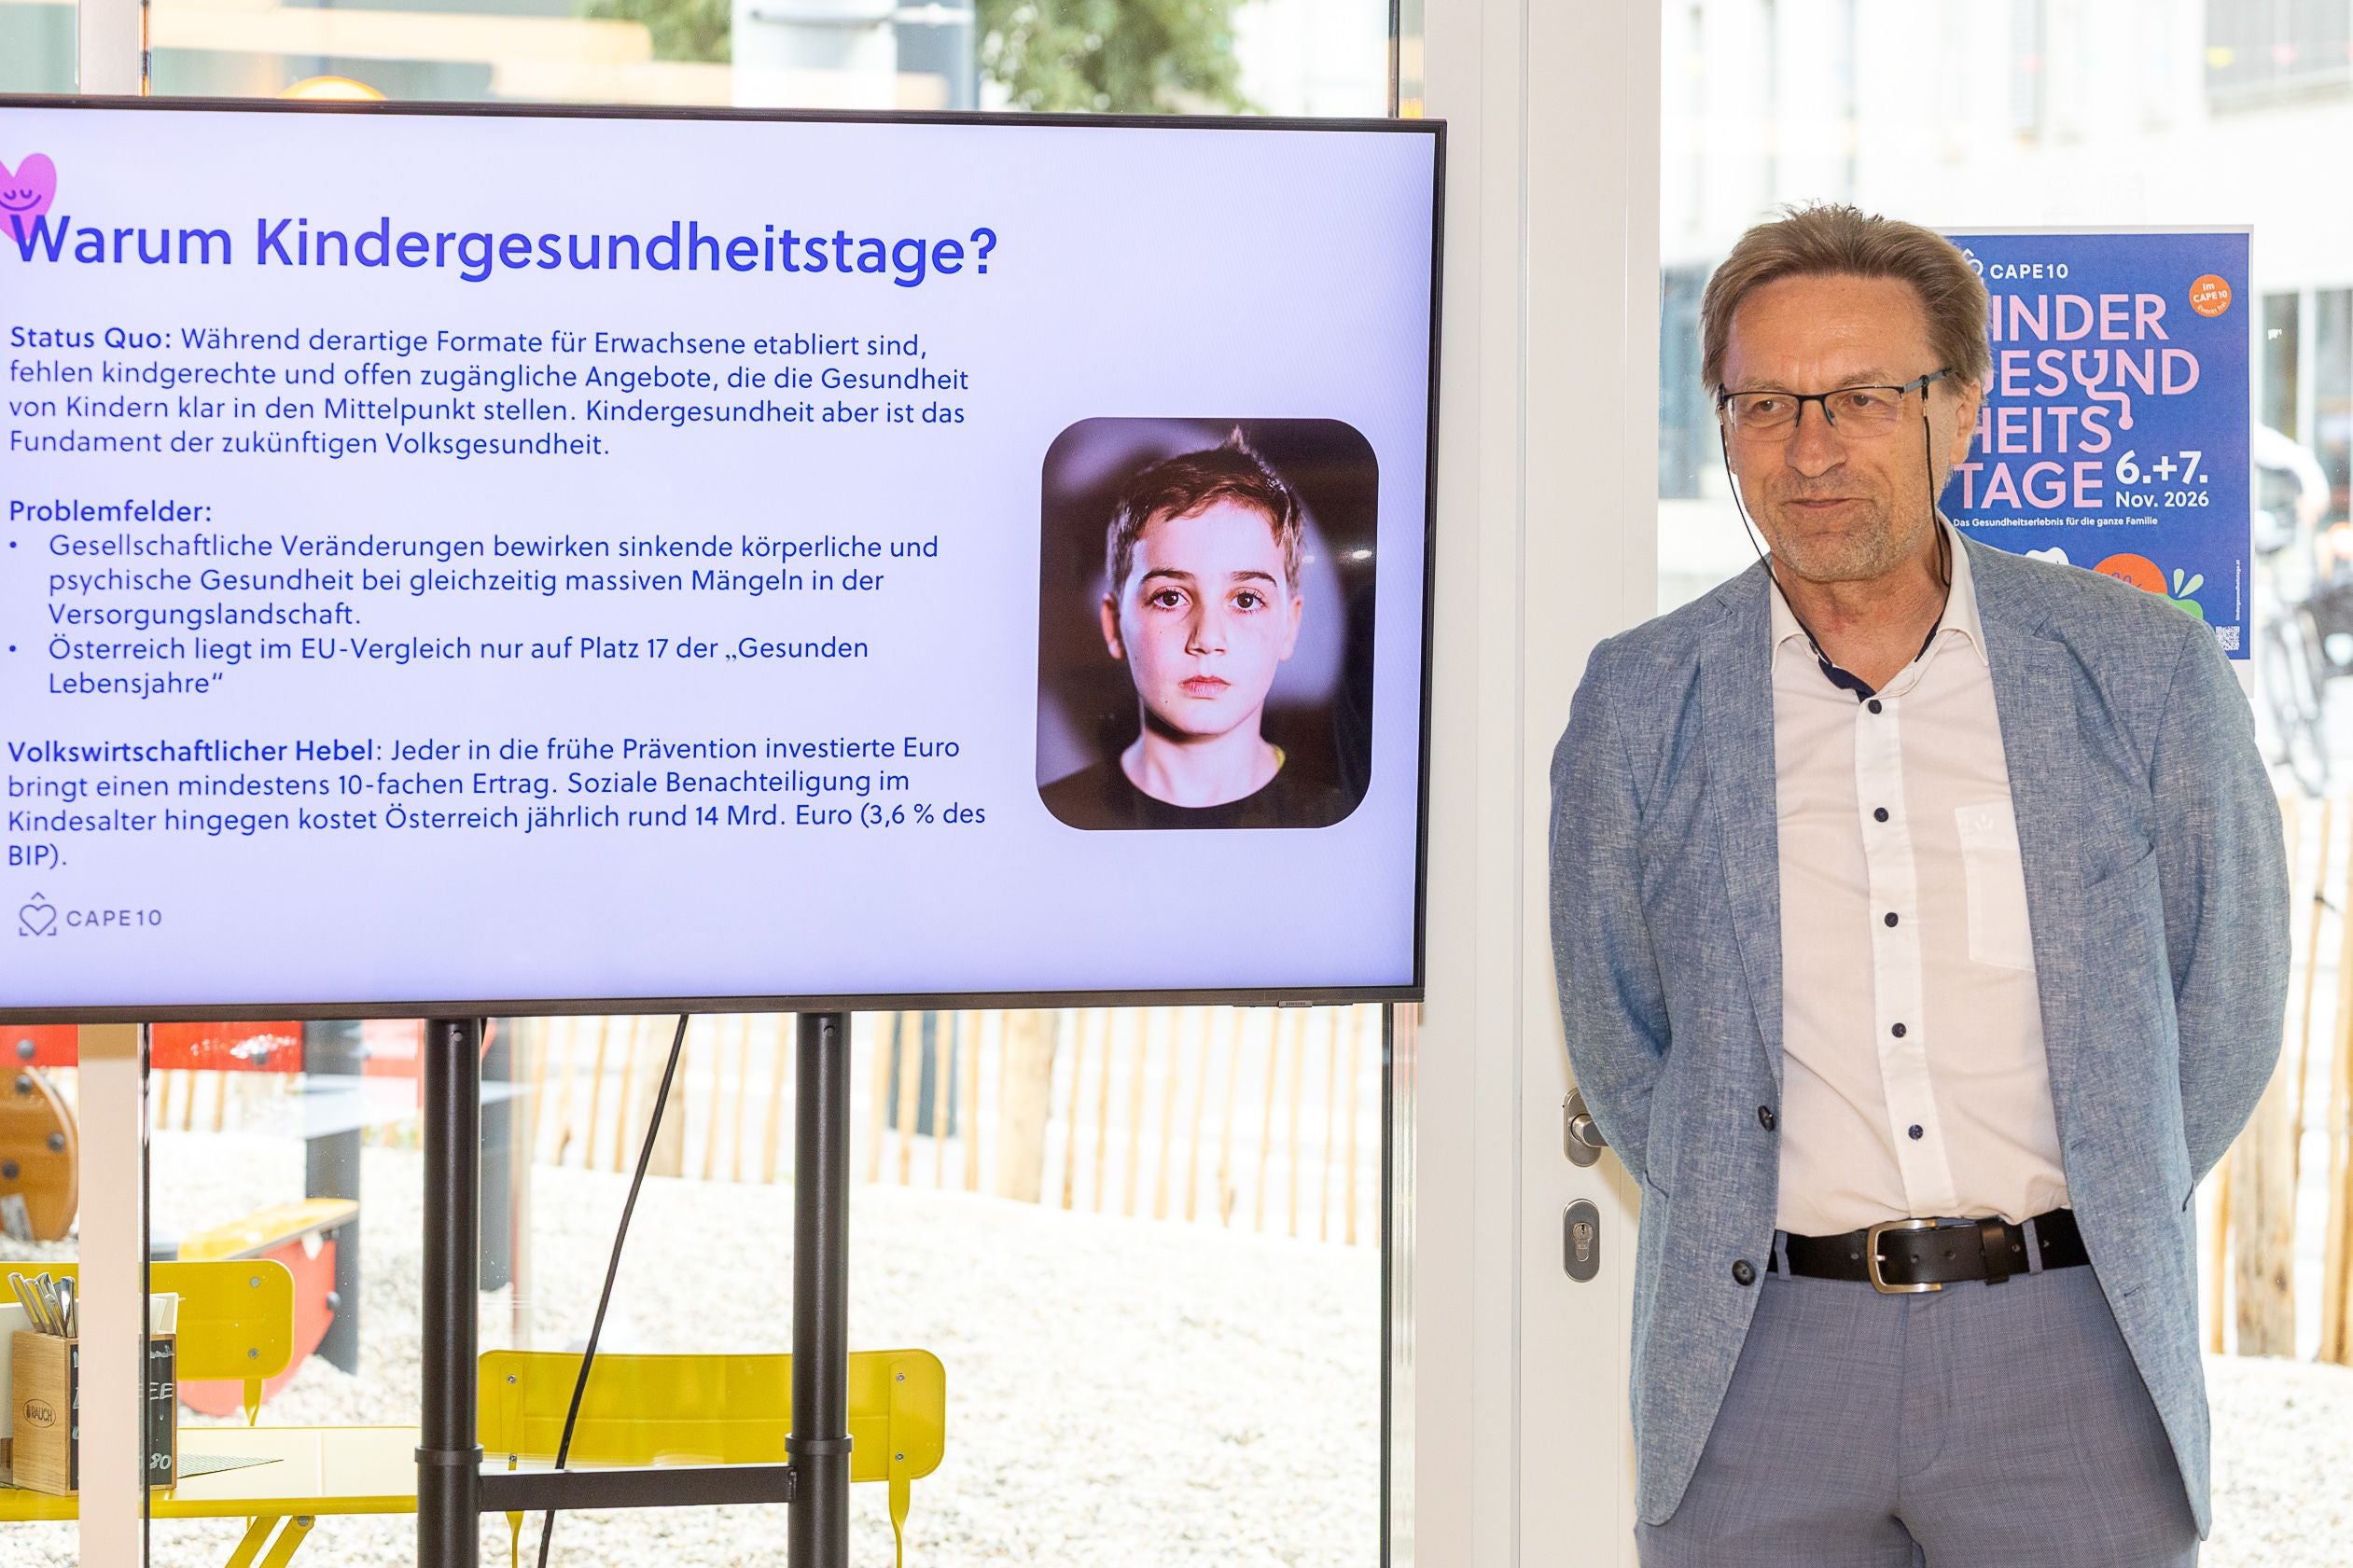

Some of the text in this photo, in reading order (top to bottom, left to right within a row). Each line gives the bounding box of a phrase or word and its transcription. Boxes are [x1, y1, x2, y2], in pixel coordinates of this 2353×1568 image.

[9, 214, 997, 288] Warum Kindergesundheitstage?
[2193, 290, 2228, 303] CAPE 10
[2202, 283, 2215, 292] Im
[1992, 294, 2170, 341] INDER
[9, 326, 926, 360] Status Quo: Während derartige Formate für Erwachsene etabliert sind,
[9, 358, 969, 394] fehlen kindgerechte und offen zugängliche Angebote, die die Gesundheit
[1983, 348, 2200, 397] ESUND
[8, 395, 965, 428] von Kindern klar in den Mittelpunkt stellen. Kindergesundheit aber ist das
[10, 428, 609, 461] Fundament der zukünftigen Volksgesundheit.
[2115, 450, 2208, 485] 6.+7.
[1954, 461, 2103, 509] TAGE
[2115, 491, 2209, 508] Nov. 2026
[9, 498, 212, 522] Problemfelder:
[1953, 516, 2158, 528] Das Gesundheitserlebnis für die ganze Familie
[49, 533, 938, 564] Gesellschaftliche Veränderungen bewirken sinkende körperliche und
[49, 567, 884, 598] psychische Gesundheit bei gleichzeitig massiven Mängeln in der
[48, 601, 361, 631] Versorgungslandschaft.
[49, 632, 186, 660] Österreich
[195, 636, 253, 666] liegt
[260, 637, 292, 659] im
[301, 635, 471, 666] EU-Vergleich
[480, 643, 524, 659] nur
[530, 635, 574, 659] auf
[580, 635, 640, 659] Platz
[647, 638, 669, 659] 17
[675, 635, 719, 659] der
[7, 736, 960, 763] Volkswirtschaftlicher Hebel: Jeder in die frühe Prävention investierte Euro
[8, 769, 910, 803] bringt einen mindestens 10-fachen Ertrag. Soziale Benachteiligung im
[8, 801, 986, 837] Kindesalter hingegen kostet Österreich jährlich rund 14 Mrd. Euro (3,6 % des
[8, 842, 67, 870] BIP).
[66, 909, 162, 927] CAPE10
[32, 1405, 53, 1422] RAUCH
